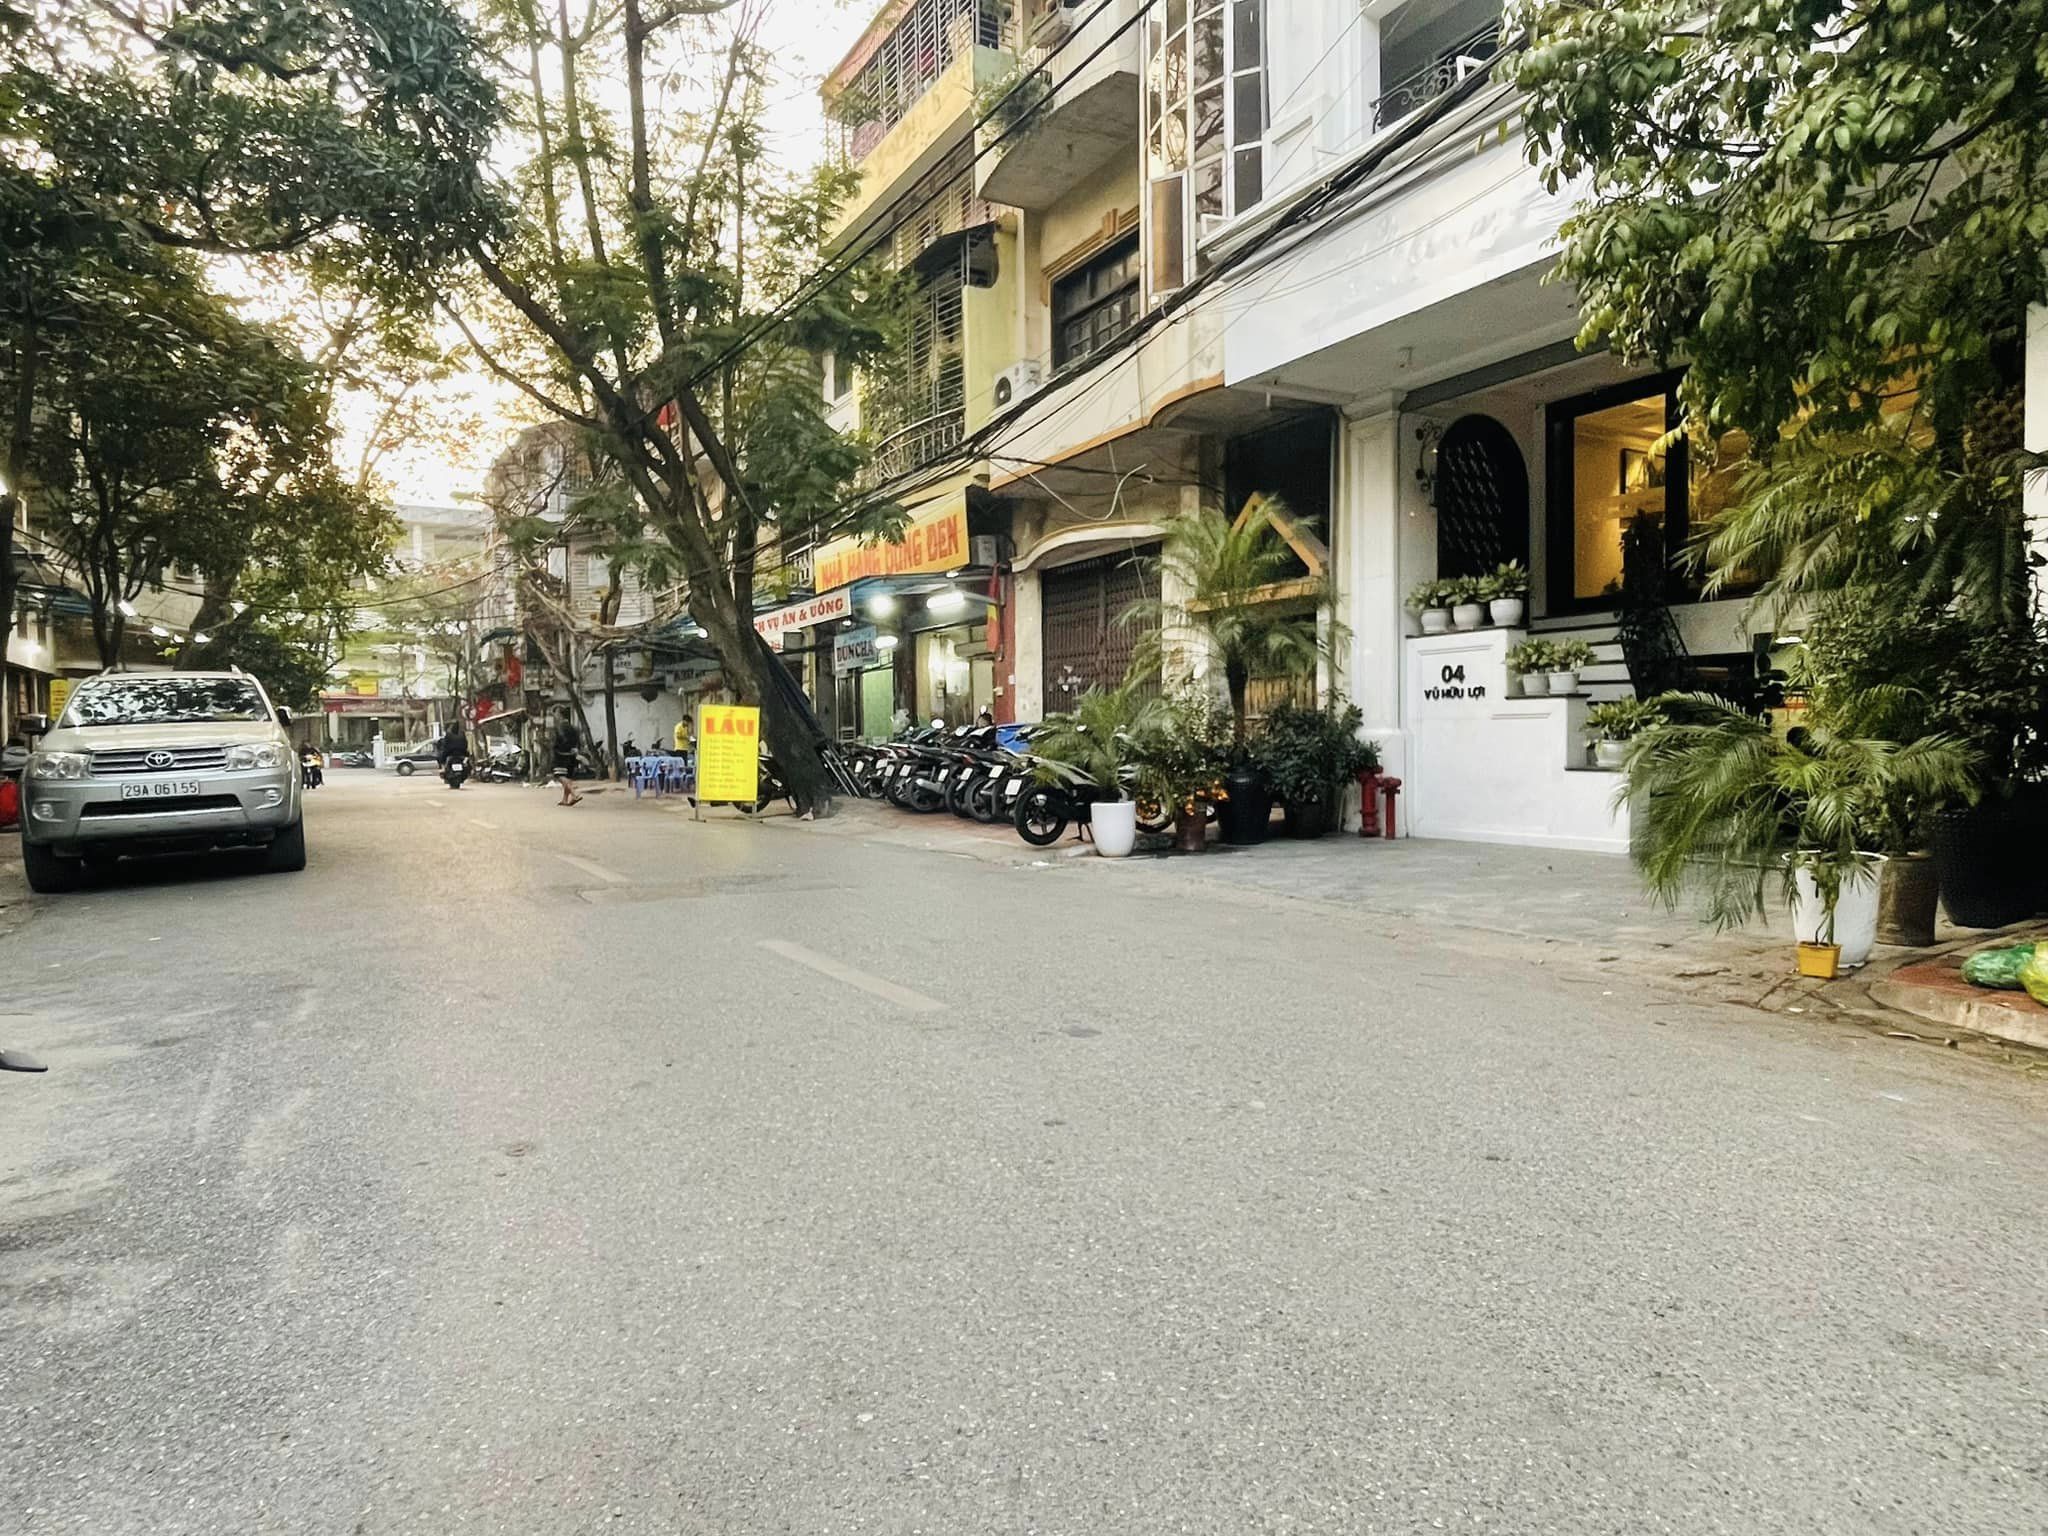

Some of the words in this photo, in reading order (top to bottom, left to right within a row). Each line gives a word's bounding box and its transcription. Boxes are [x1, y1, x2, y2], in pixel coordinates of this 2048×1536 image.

[799, 609, 808, 621] &
[1441, 664, 1466, 684] 04
[124, 784, 149, 797] 29A
